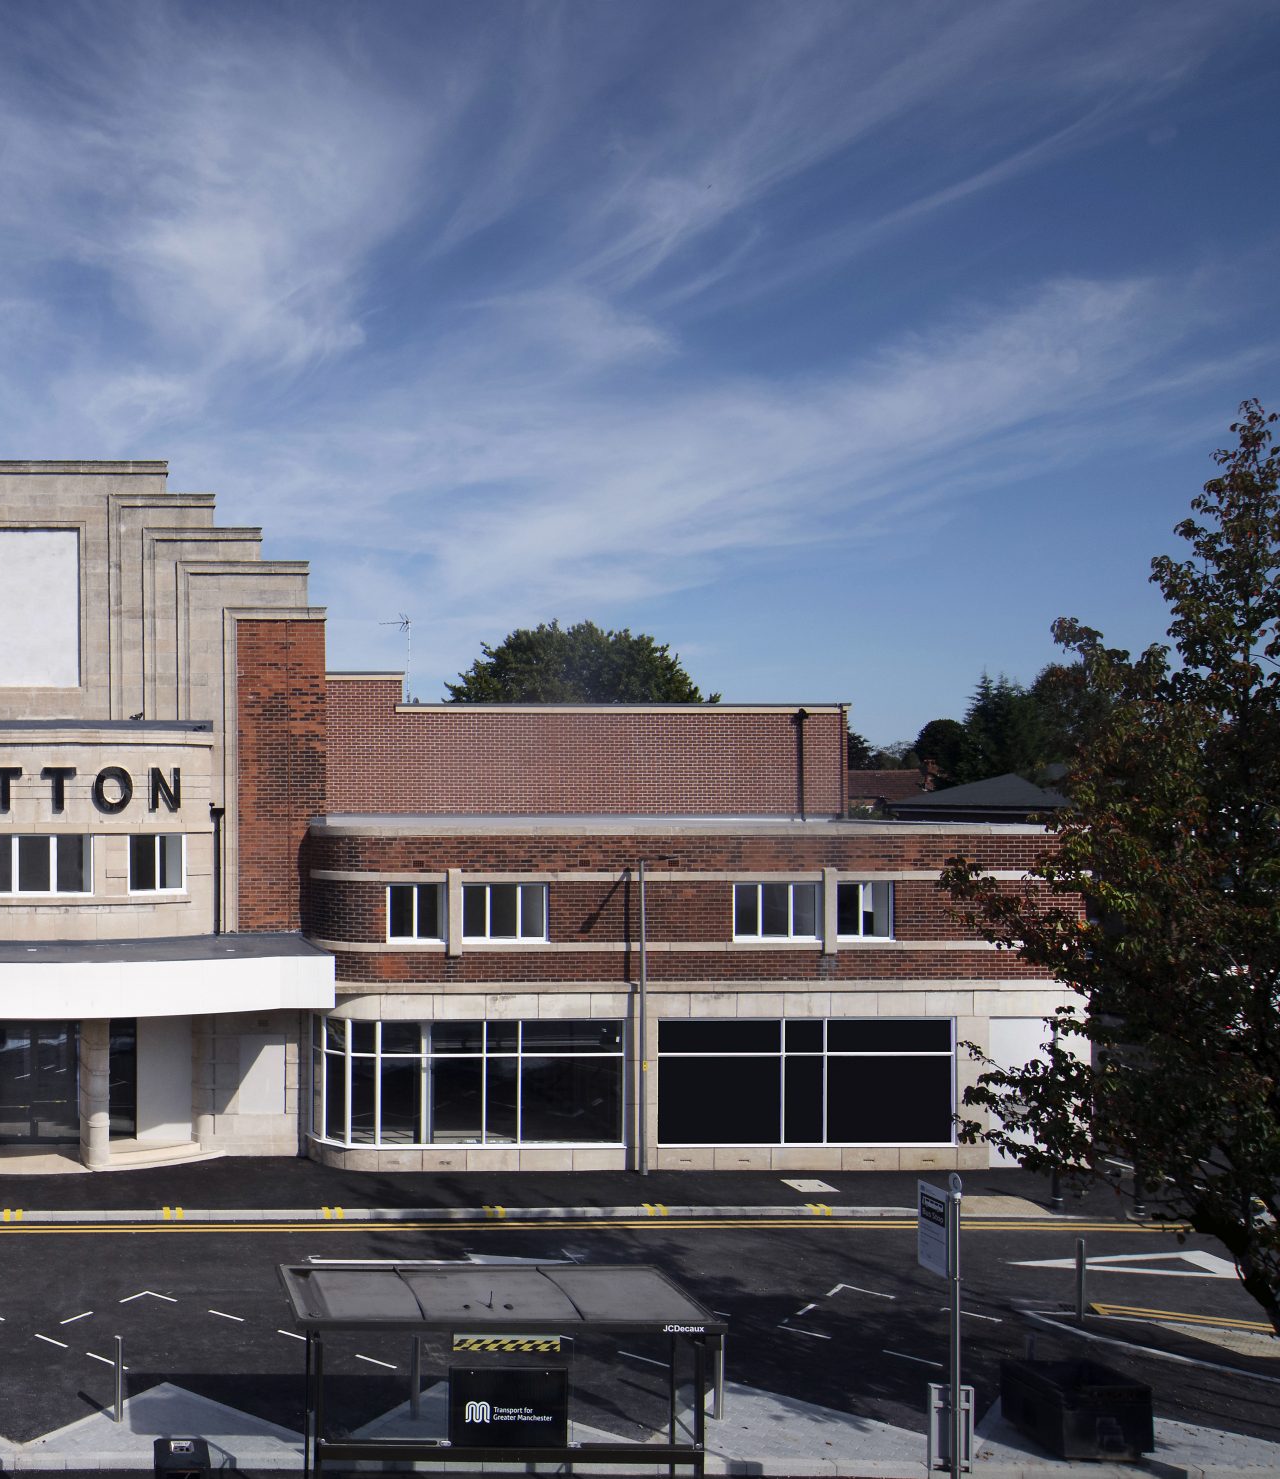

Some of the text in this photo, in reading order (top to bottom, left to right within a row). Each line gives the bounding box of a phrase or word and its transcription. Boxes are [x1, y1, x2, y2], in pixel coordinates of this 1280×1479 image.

[662, 1324, 705, 1333] JCDecaux
[493, 1406, 533, 1414] Transport for
[517, 1414, 553, 1422] Manchester
